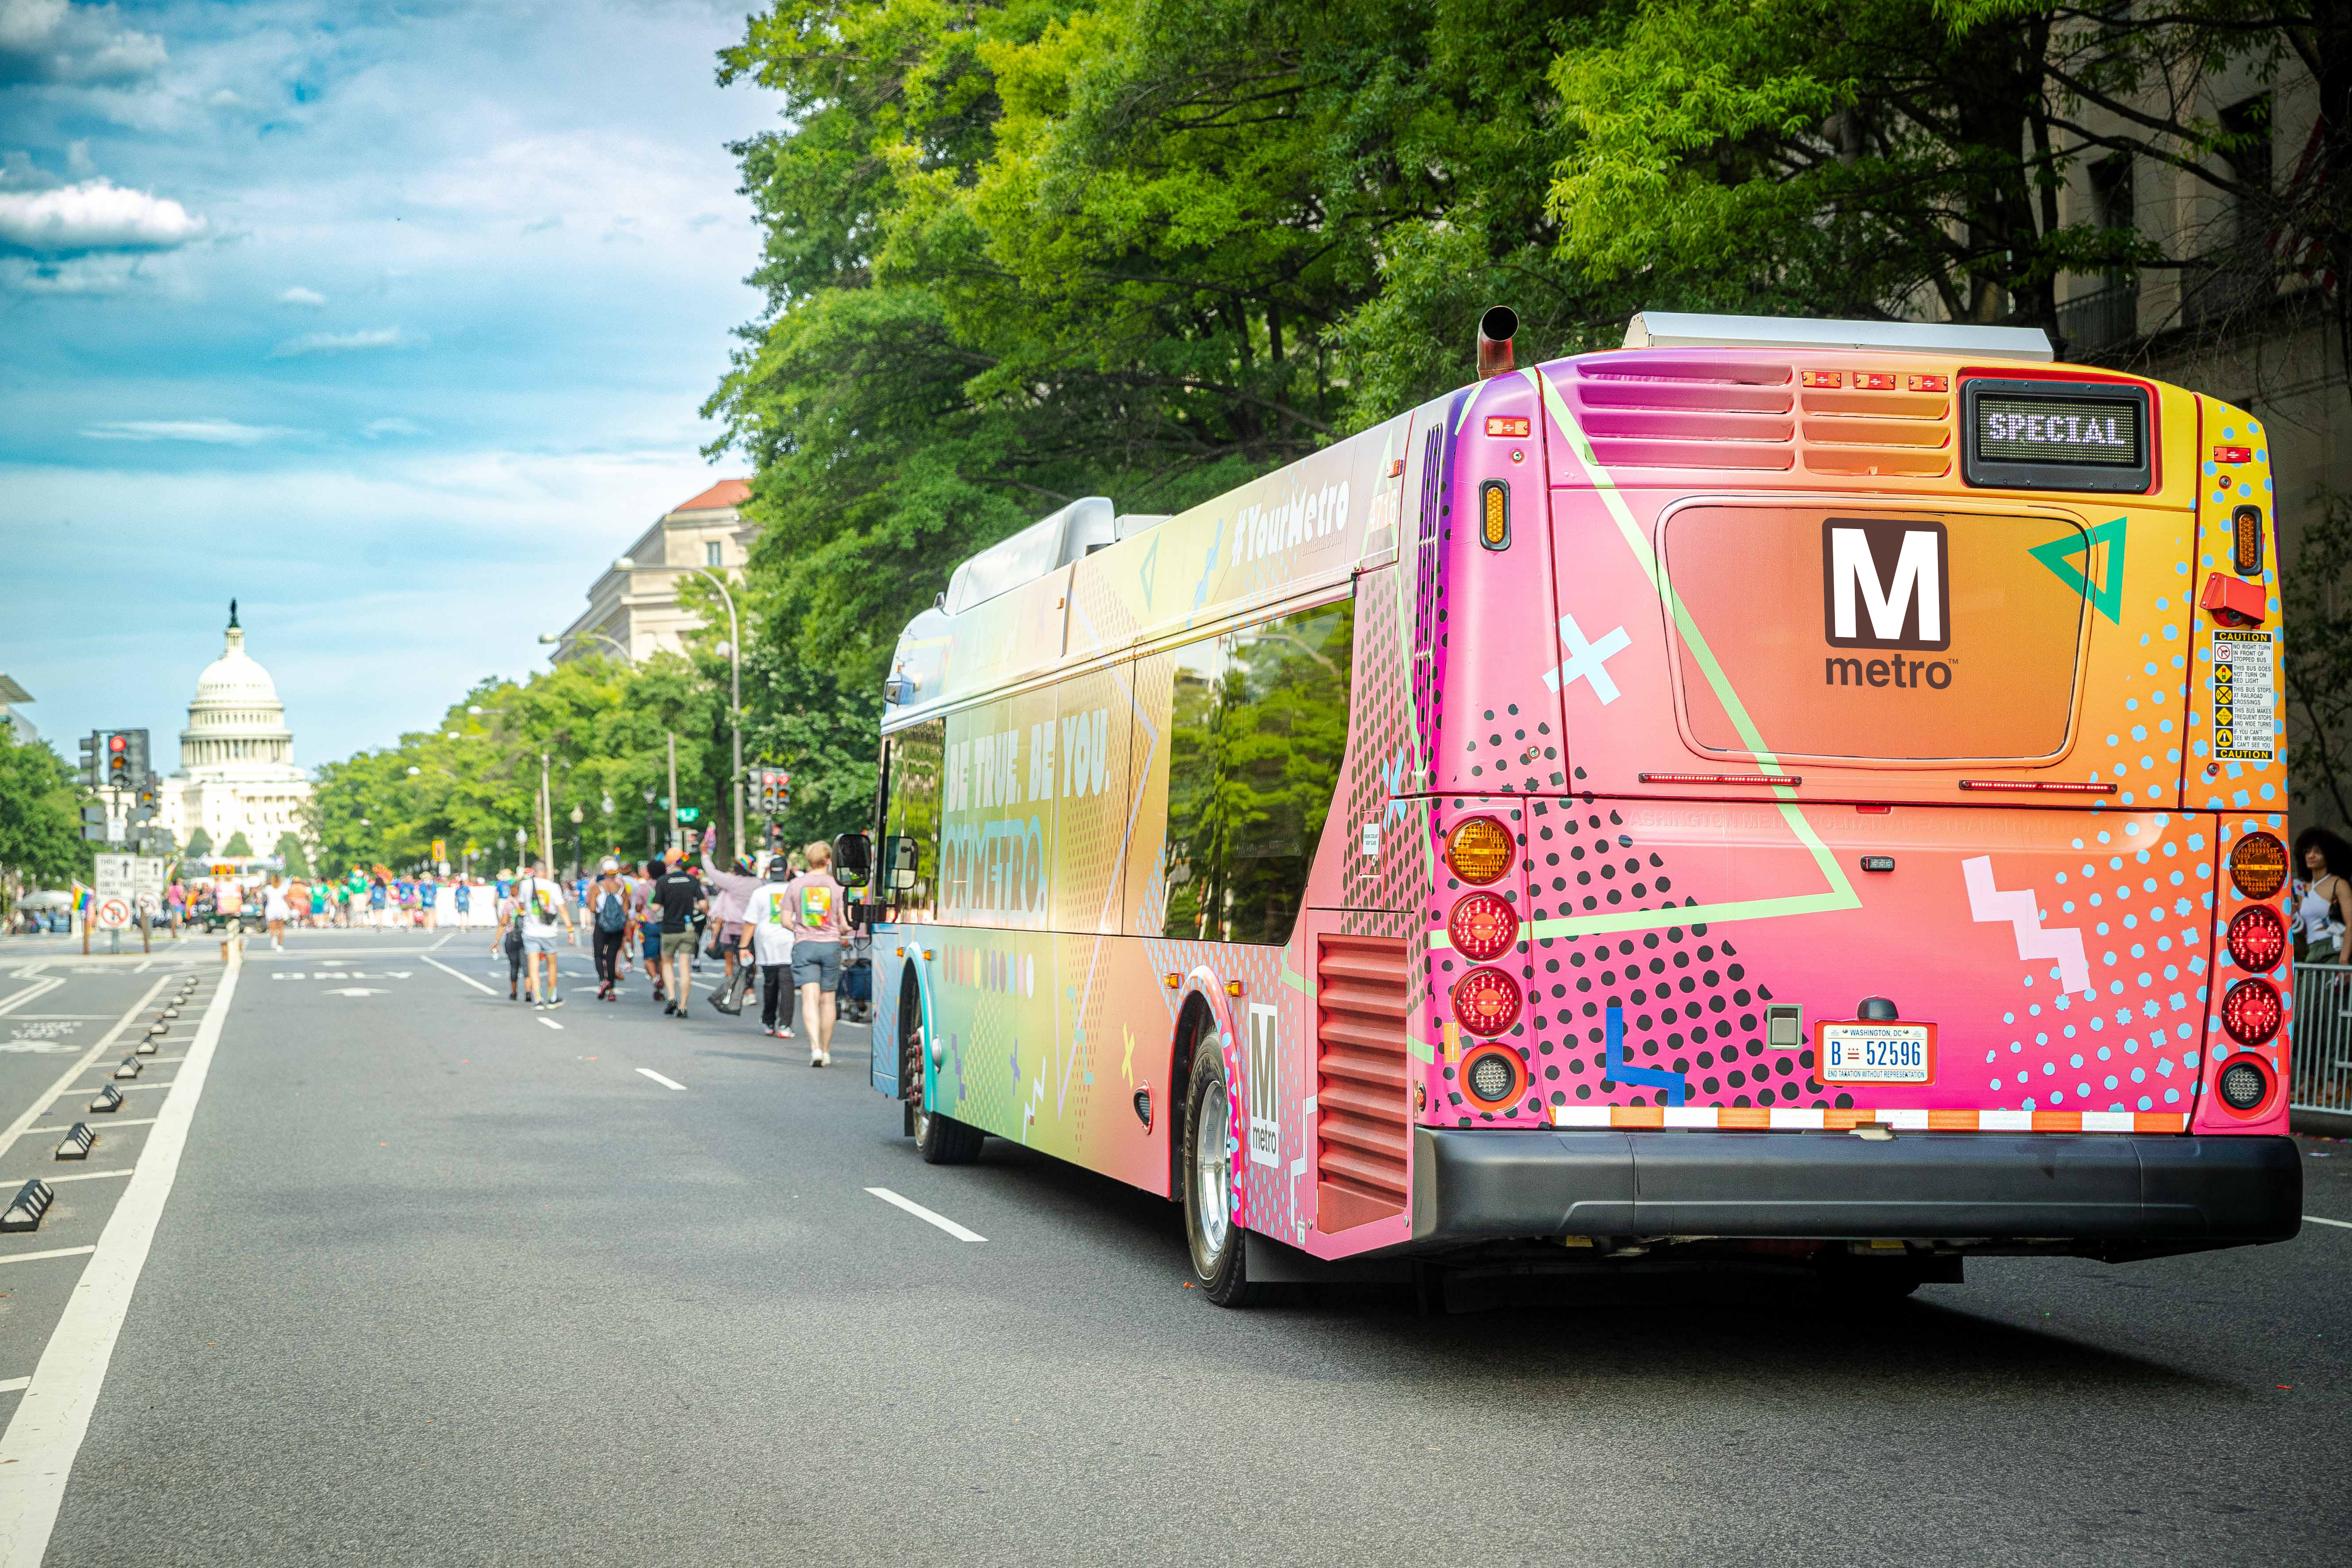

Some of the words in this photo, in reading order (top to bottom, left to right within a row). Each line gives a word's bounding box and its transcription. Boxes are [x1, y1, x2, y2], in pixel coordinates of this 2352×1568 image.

[1989, 413, 2124, 444] SPECIAL
[1232, 478, 1349, 567] #YourMetro
[1832, 528, 1940, 641] M
[2220, 633, 2267, 641] CAUTION
[1826, 654, 1952, 689] metro
[948, 740, 969, 812] BE
[974, 730, 1021, 808] TRUE.
[1028, 721, 1054, 802] BE
[1062, 709, 1110, 798] YOU.
[2220, 749, 2268, 758] CAUTION
[944, 834, 969, 910] ON
[972, 831, 1045, 912] METRO.
[1251, 1012, 1276, 1122] M
[1832, 1041, 1840, 1065] B
[1867, 1041, 1920, 1065] 52596
[1253, 1124, 1276, 1154] metro
